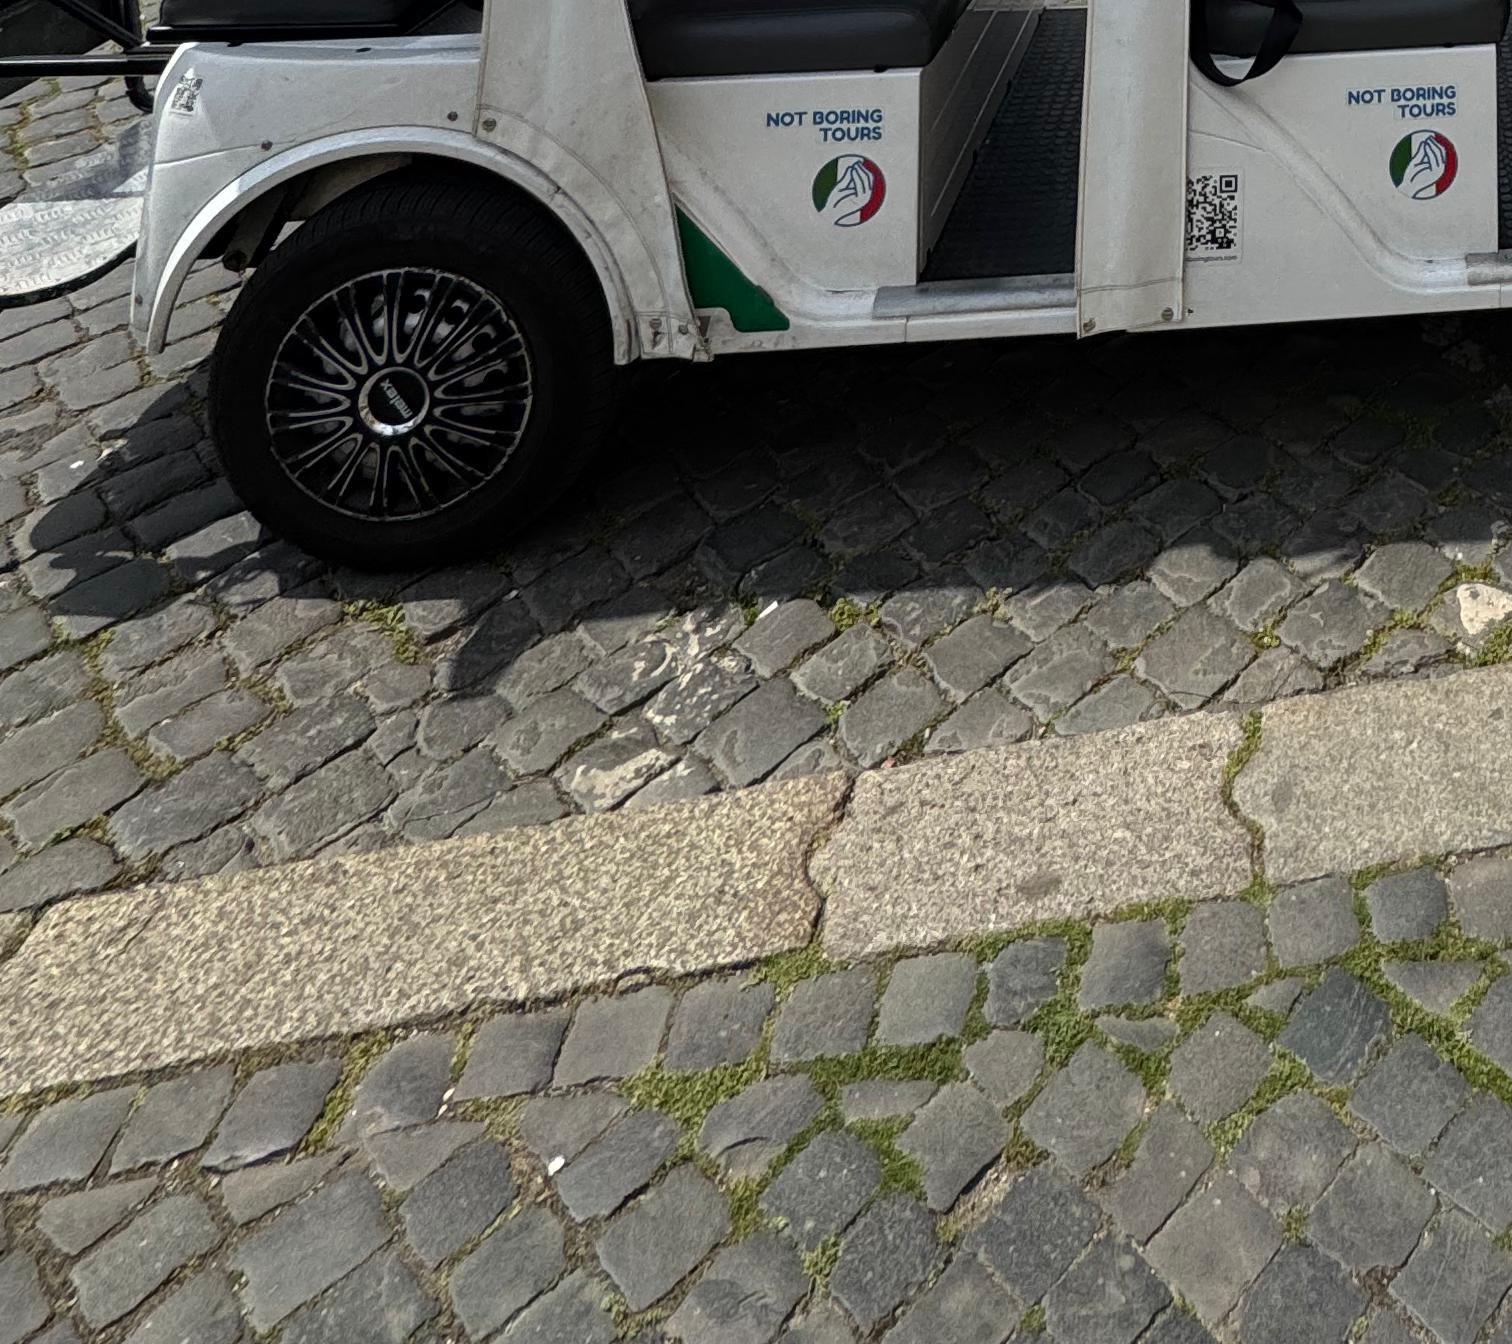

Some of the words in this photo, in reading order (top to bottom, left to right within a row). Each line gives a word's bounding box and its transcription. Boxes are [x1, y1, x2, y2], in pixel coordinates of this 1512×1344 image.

[1347, 89, 1386, 105] NOT
[1390, 85, 1456, 102] BORING
[766, 111, 808, 127] NOT
[812, 109, 883, 125] BORING
[1397, 101, 1457, 118] TOURS
[819, 126, 882, 142] TOURS
[380, 378, 413, 419] melex
